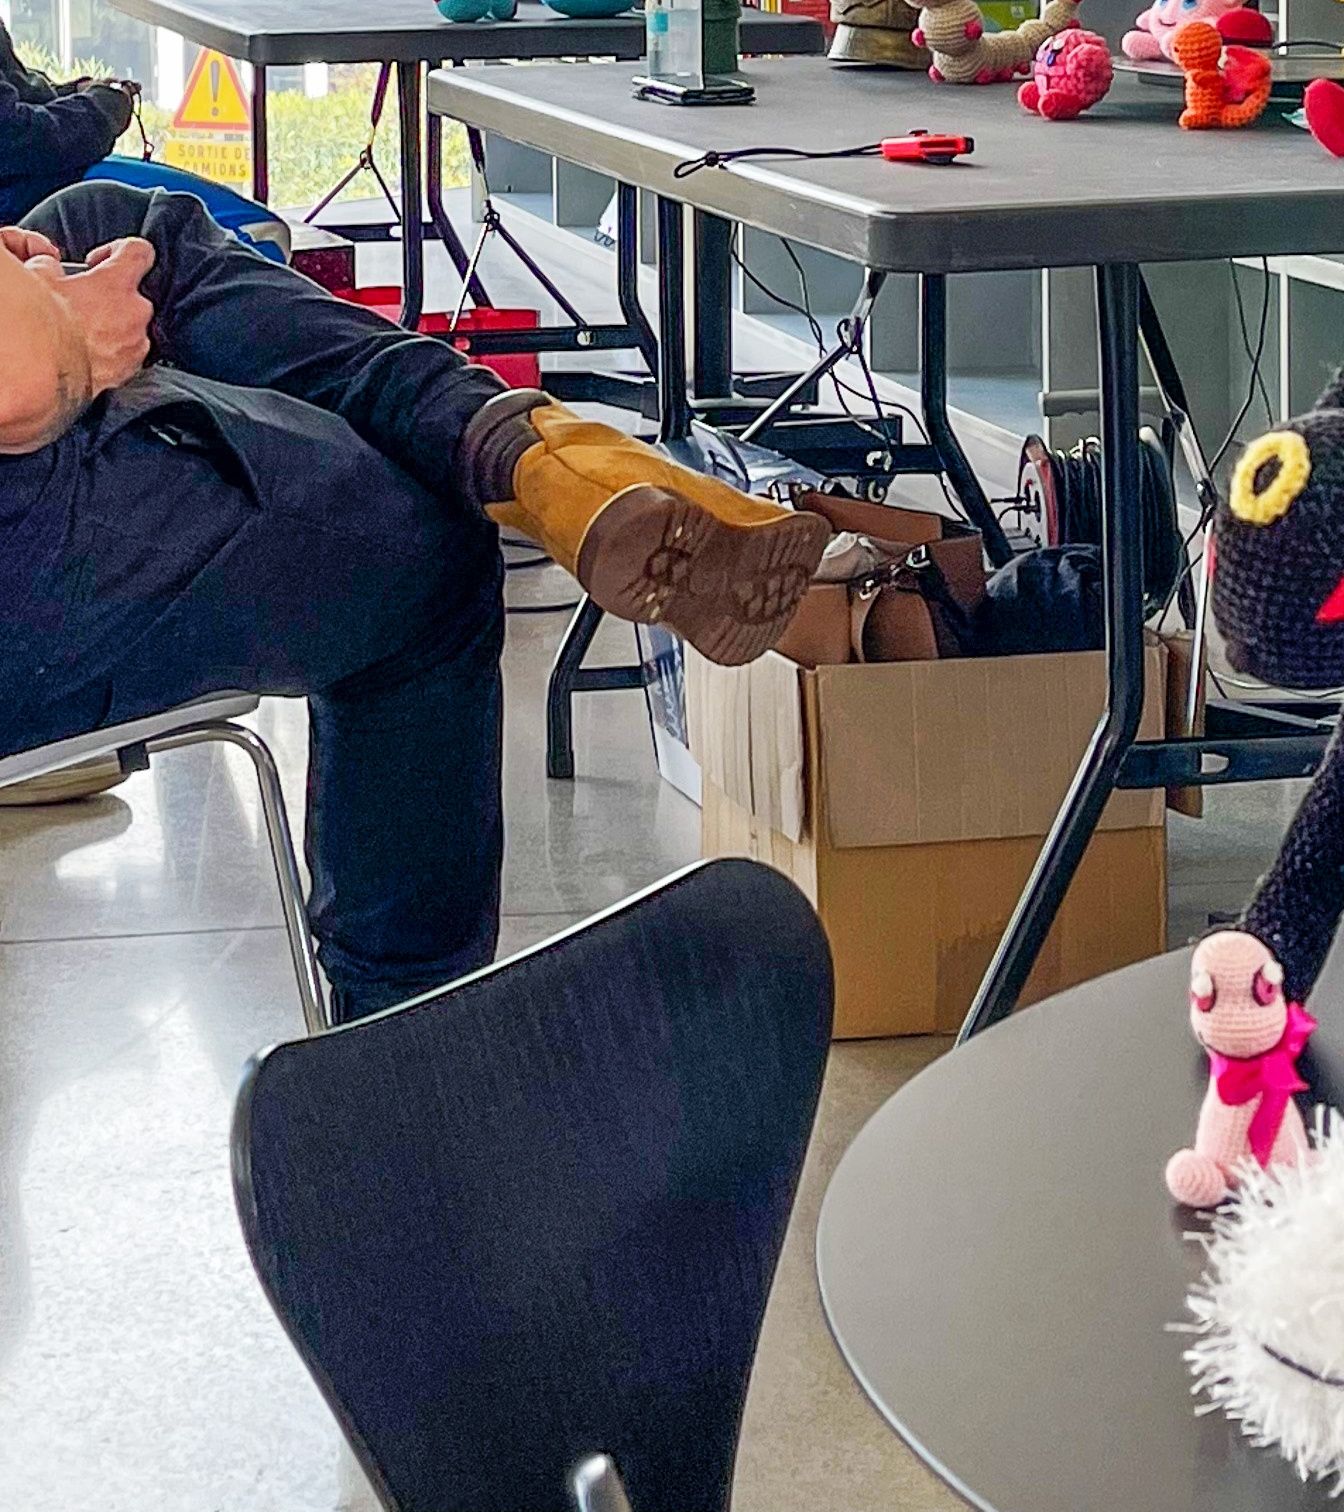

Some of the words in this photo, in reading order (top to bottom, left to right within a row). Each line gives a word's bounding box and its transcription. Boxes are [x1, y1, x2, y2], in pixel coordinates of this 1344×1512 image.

[178, 143, 229, 160] SORTIE
[235, 146, 251, 161] DE
[183, 160, 247, 178] CAMIONS
